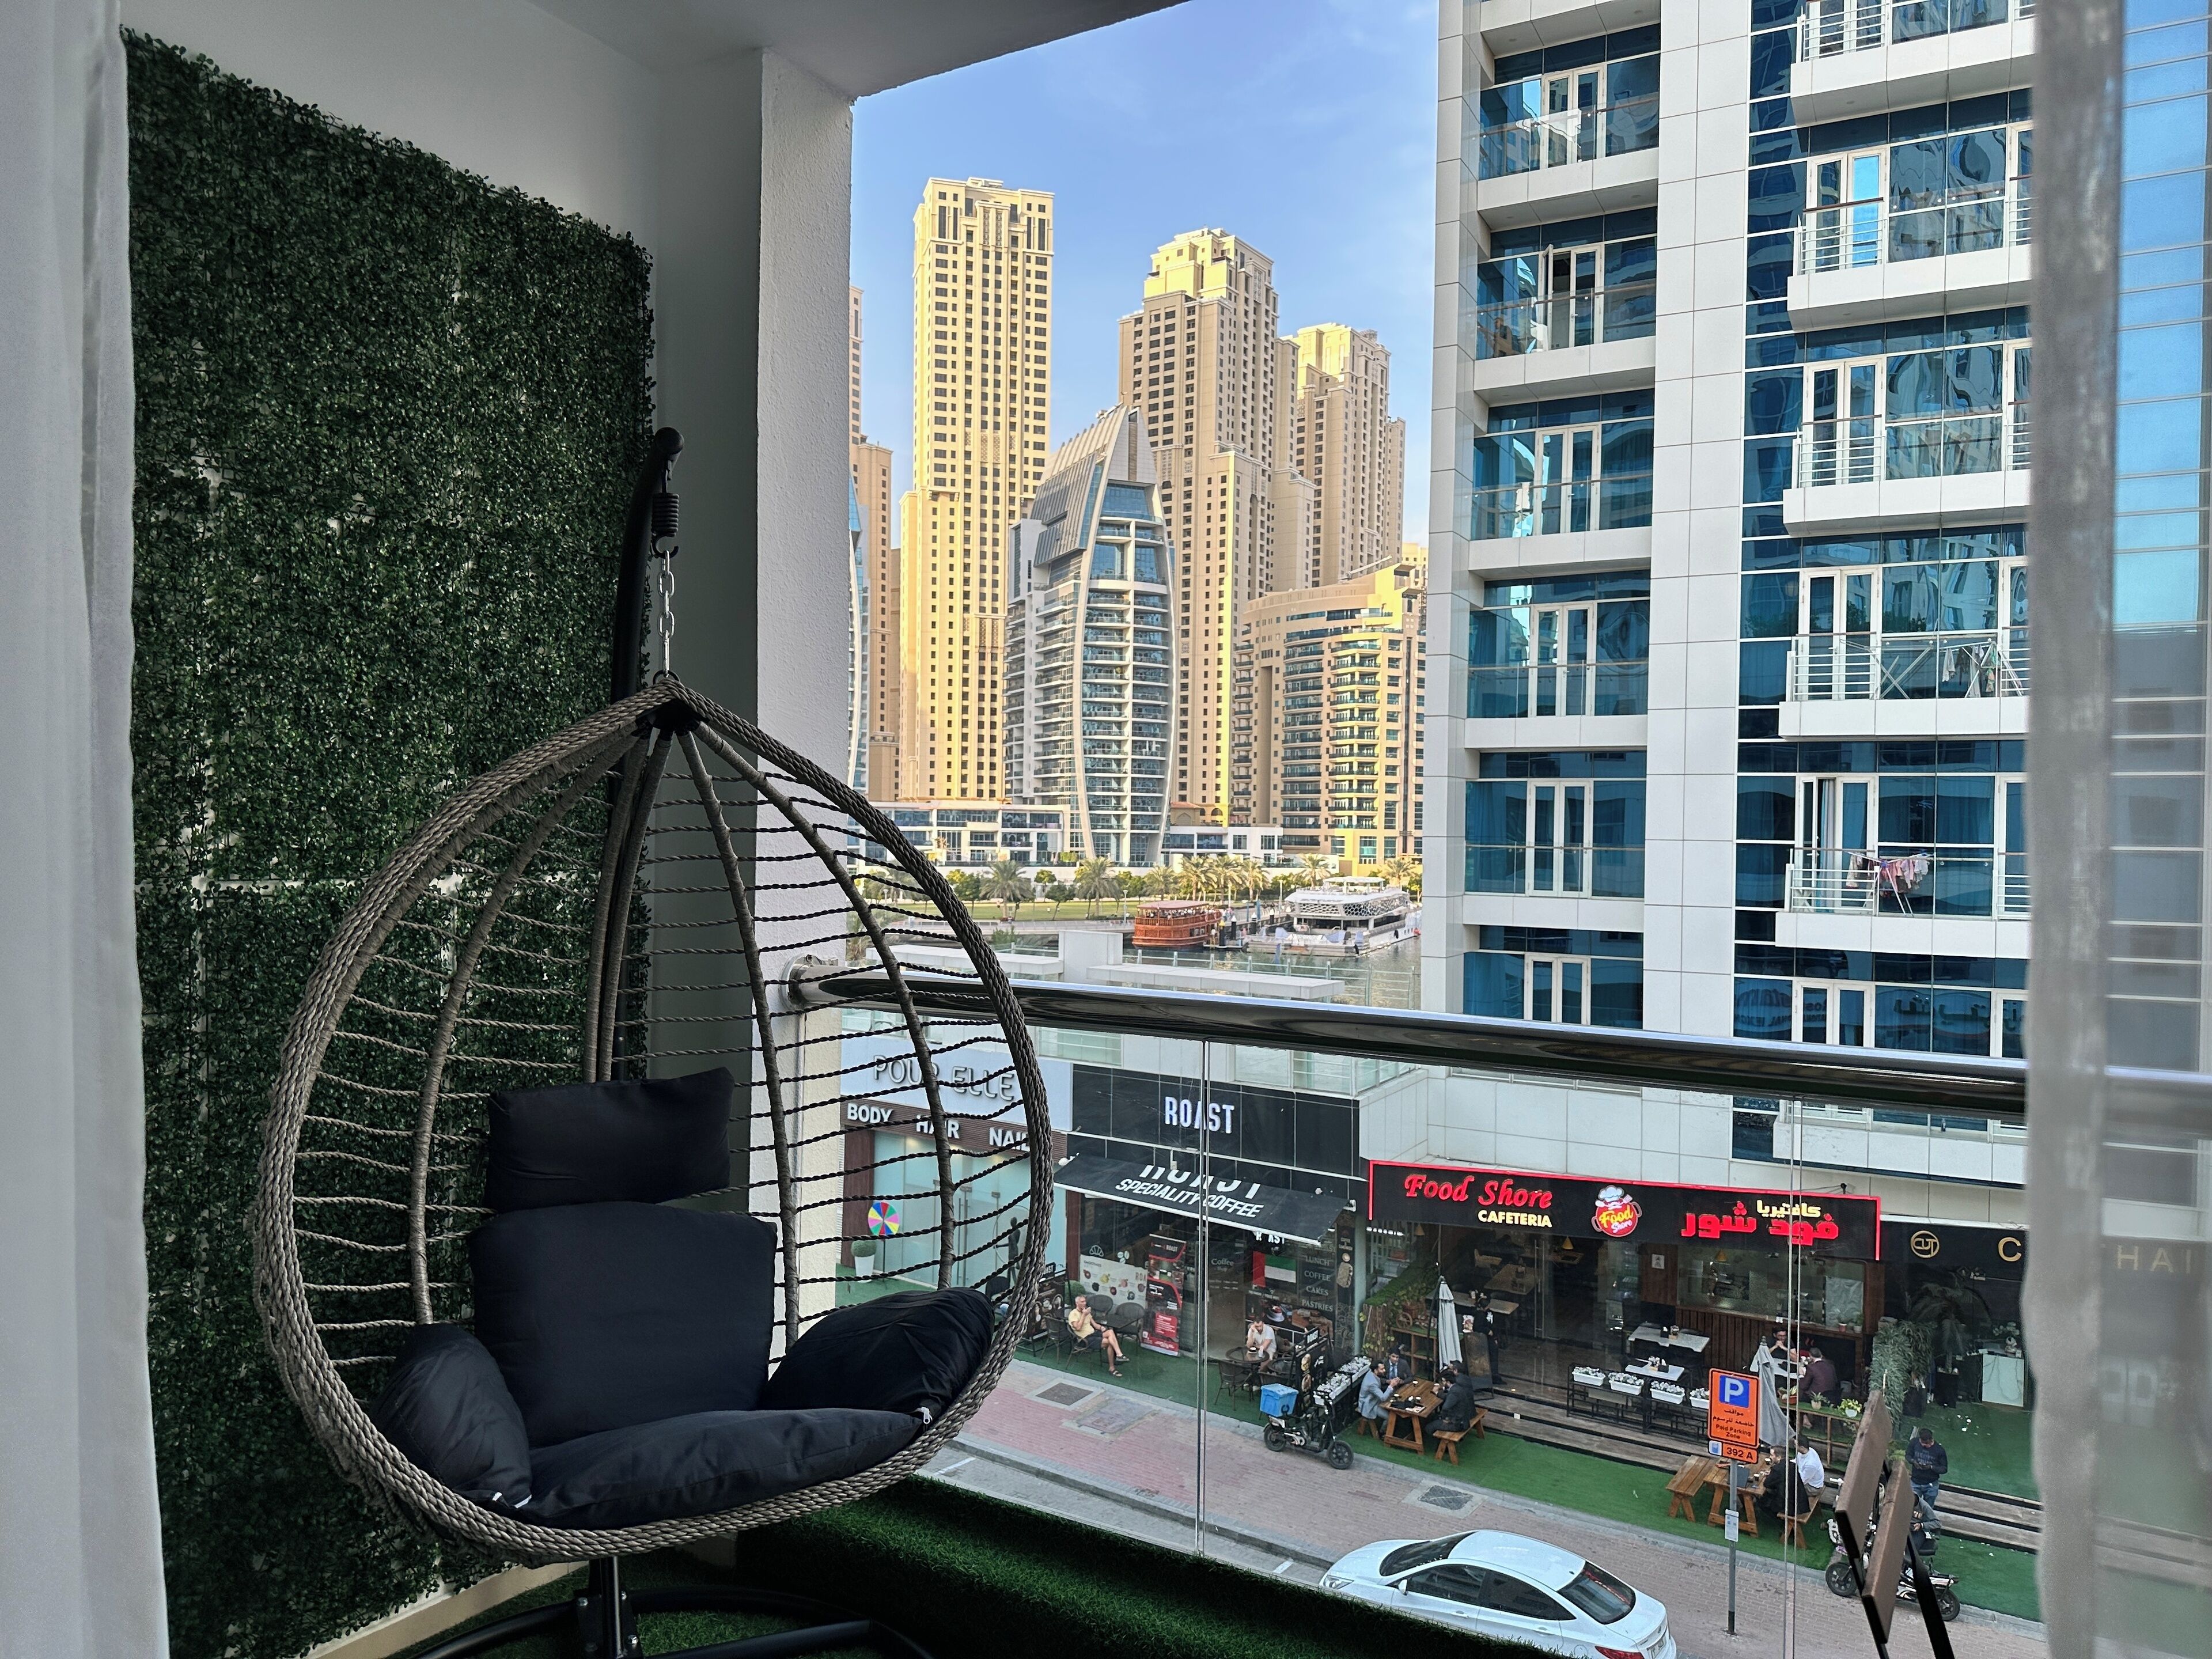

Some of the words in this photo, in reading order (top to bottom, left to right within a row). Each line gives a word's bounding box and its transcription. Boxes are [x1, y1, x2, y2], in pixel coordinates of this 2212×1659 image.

[951, 1066, 1016, 1101] ELLE
[847, 1103, 894, 1123] BODY
[916, 1114, 960, 1139] HR
[1165, 1096, 1234, 1134] ROAST
[1115, 1179, 1200, 1206] SPECIALITY
[1202, 1194, 1264, 1218] COFFEE
[1404, 1174, 1475, 1202] Food
[1478, 1179, 1552, 1209] Shore
[1478, 1209, 1552, 1228] CAFETERIA
[1599, 1205, 1634, 1228] Food
[1681, 1200, 1757, 1238] شور
[1757, 1200, 1821, 1218] كافتيريا
[1768, 1213, 1839, 1247] فود
[1304, 1270, 1331, 1282] COFFEE
[1306, 1285, 1329, 1296] CAKES
[1301, 1299, 1334, 1312] PASTRIES
[1724, 1377, 1744, 1403] P
[1726, 1431, 1741, 1440] Zone
[1729, 1426, 1751, 1437] Parking
[1726, 1447, 1744, 1458] 392
[1746, 1452, 1753, 1460] A
